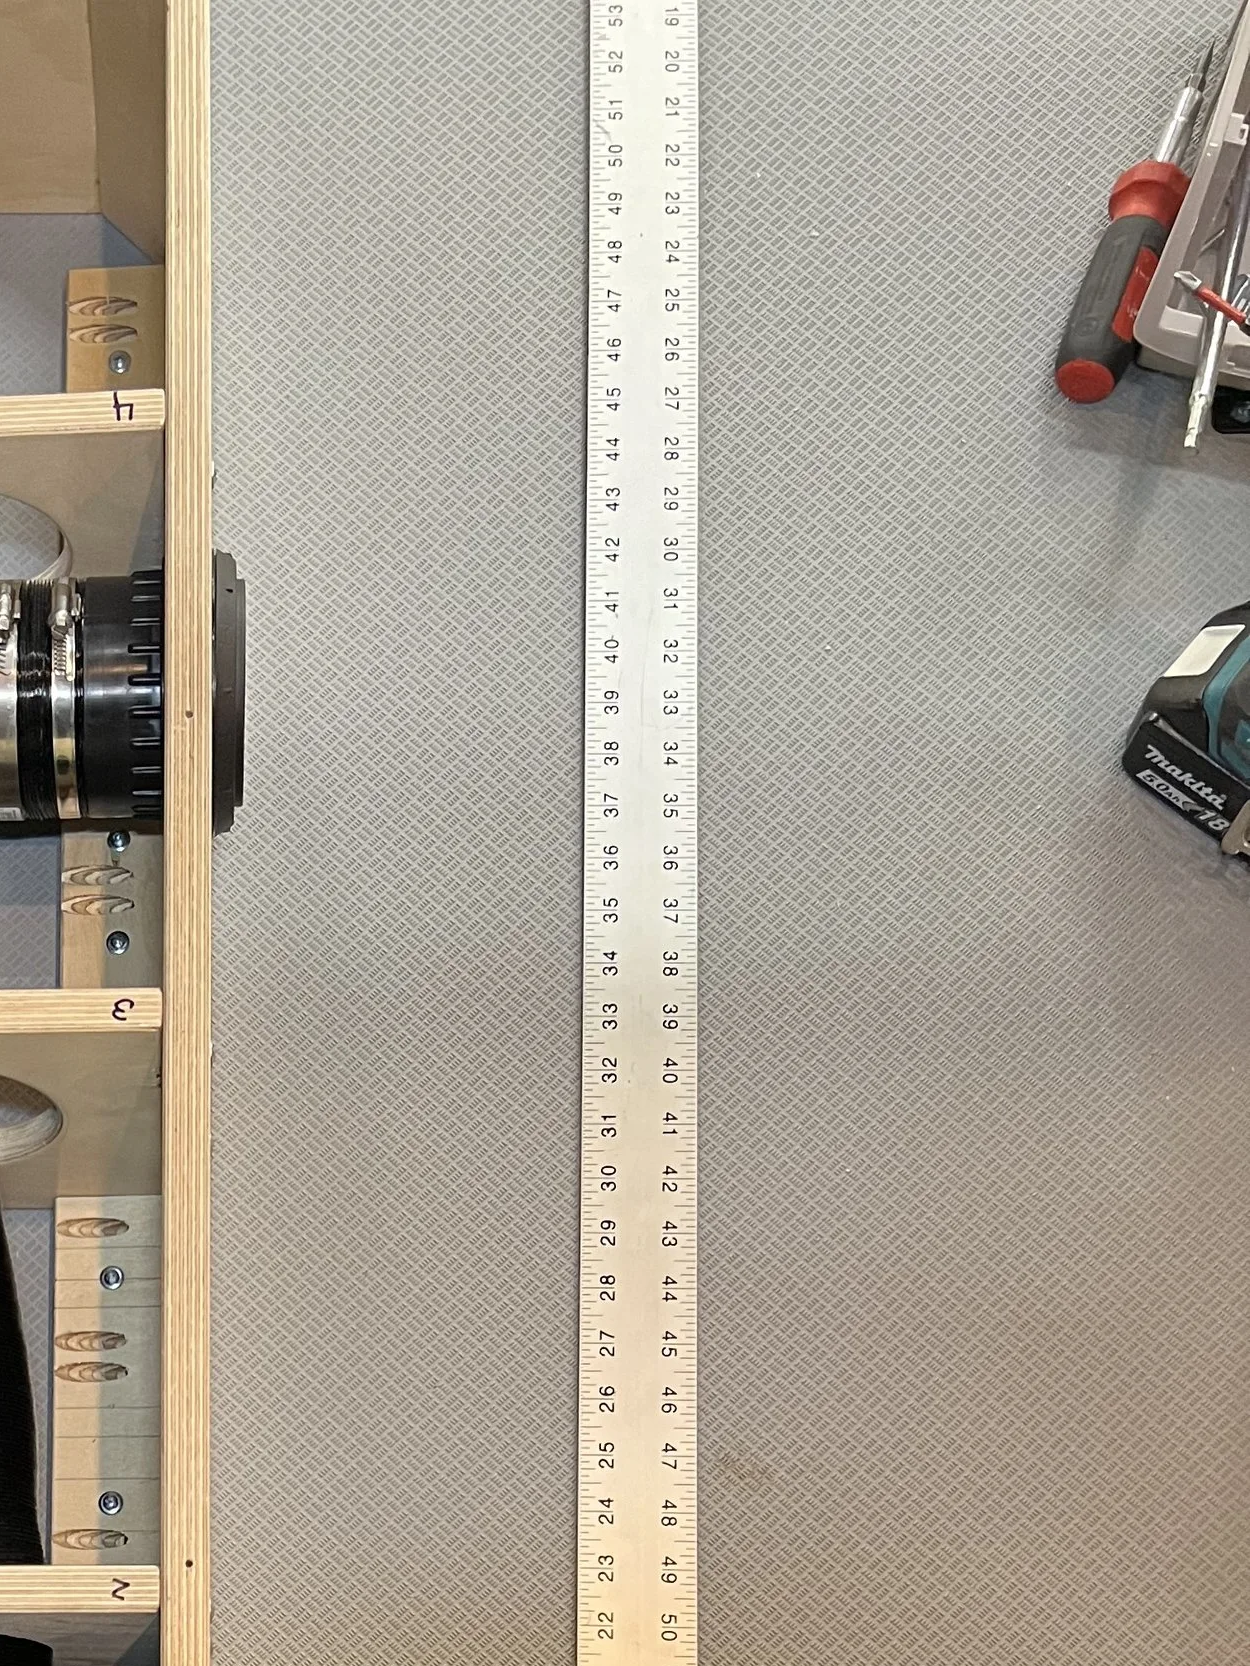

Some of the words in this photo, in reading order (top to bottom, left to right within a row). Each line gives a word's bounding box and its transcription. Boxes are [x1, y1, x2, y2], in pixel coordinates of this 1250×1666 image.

[608, 4, 623, 27] 53
[664, 6, 680, 27] 19
[608, 51, 623, 73] 52
[664, 50, 680, 73] 20
[608, 100, 623, 121] 51
[665, 97, 680, 117] 21
[607, 144, 623, 168] 50
[665, 143, 681, 167] 22
[607, 192, 623, 216] 49
[664, 191, 681, 215] 23
[607, 240, 623, 264] 48
[664, 240, 681, 264] 24
[606, 288, 622, 313] 47
[664, 288, 680, 312] 25
[606, 338, 622, 362] 46
[664, 337, 680, 362] 26
[113, 390, 134, 422] 4
[606, 387, 622, 412] 45
[664, 386, 680, 411] 27
[605, 437, 621, 462] 44
[663, 436, 680, 461] 28
[605, 487, 621, 512] 43
[663, 486, 680, 511] 29
[604, 537, 620, 563] 42
[663, 537, 679, 562] 30
[604, 591, 620, 613] 41
[663, 587, 679, 609] 31
[603, 638, 620, 664] 40
[663, 639, 679, 664] 32
[603, 690, 620, 715] 39
[662, 689, 679, 716] 33
[603, 740, 620, 766] 38
[663, 741, 679, 766] 34
[603, 792, 619, 818] 37
[662, 793, 679, 819] 35
[602, 845, 619, 871] 36
[662, 845, 679, 871] 36
[602, 897, 619, 924] 35
[662, 897, 679, 924] 37
[601, 950, 619, 977] 34
[662, 950, 679, 977] 38
[111, 998, 135, 1021] 3
[601, 1003, 619, 1031] 33
[662, 1003, 679, 1030] 39
[601, 1057, 618, 1084] 32
[662, 1057, 679, 1084] 40
[600, 1115, 618, 1138] 31
[662, 1111, 679, 1135] 41
[600, 1165, 617, 1192] 30
[661, 1165, 679, 1193] 42
[599, 1219, 617, 1247] 29
[661, 1220, 679, 1248] 43
[599, 1274, 616, 1302] 28
[661, 1275, 678, 1303] 44
[598, 1329, 615, 1357] 27
[661, 1330, 678, 1358] 45
[598, 1385, 616, 1413] 26
[661, 1385, 678, 1414] 46
[598, 1441, 615, 1469] 25
[661, 1442, 678, 1470] 47
[597, 1497, 615, 1526] 24
[661, 1498, 678, 1527] 48
[597, 1554, 615, 1583] 23
[661, 1555, 678, 1584] 49
[597, 1612, 614, 1640] 22
[661, 1612, 679, 1642] 50
